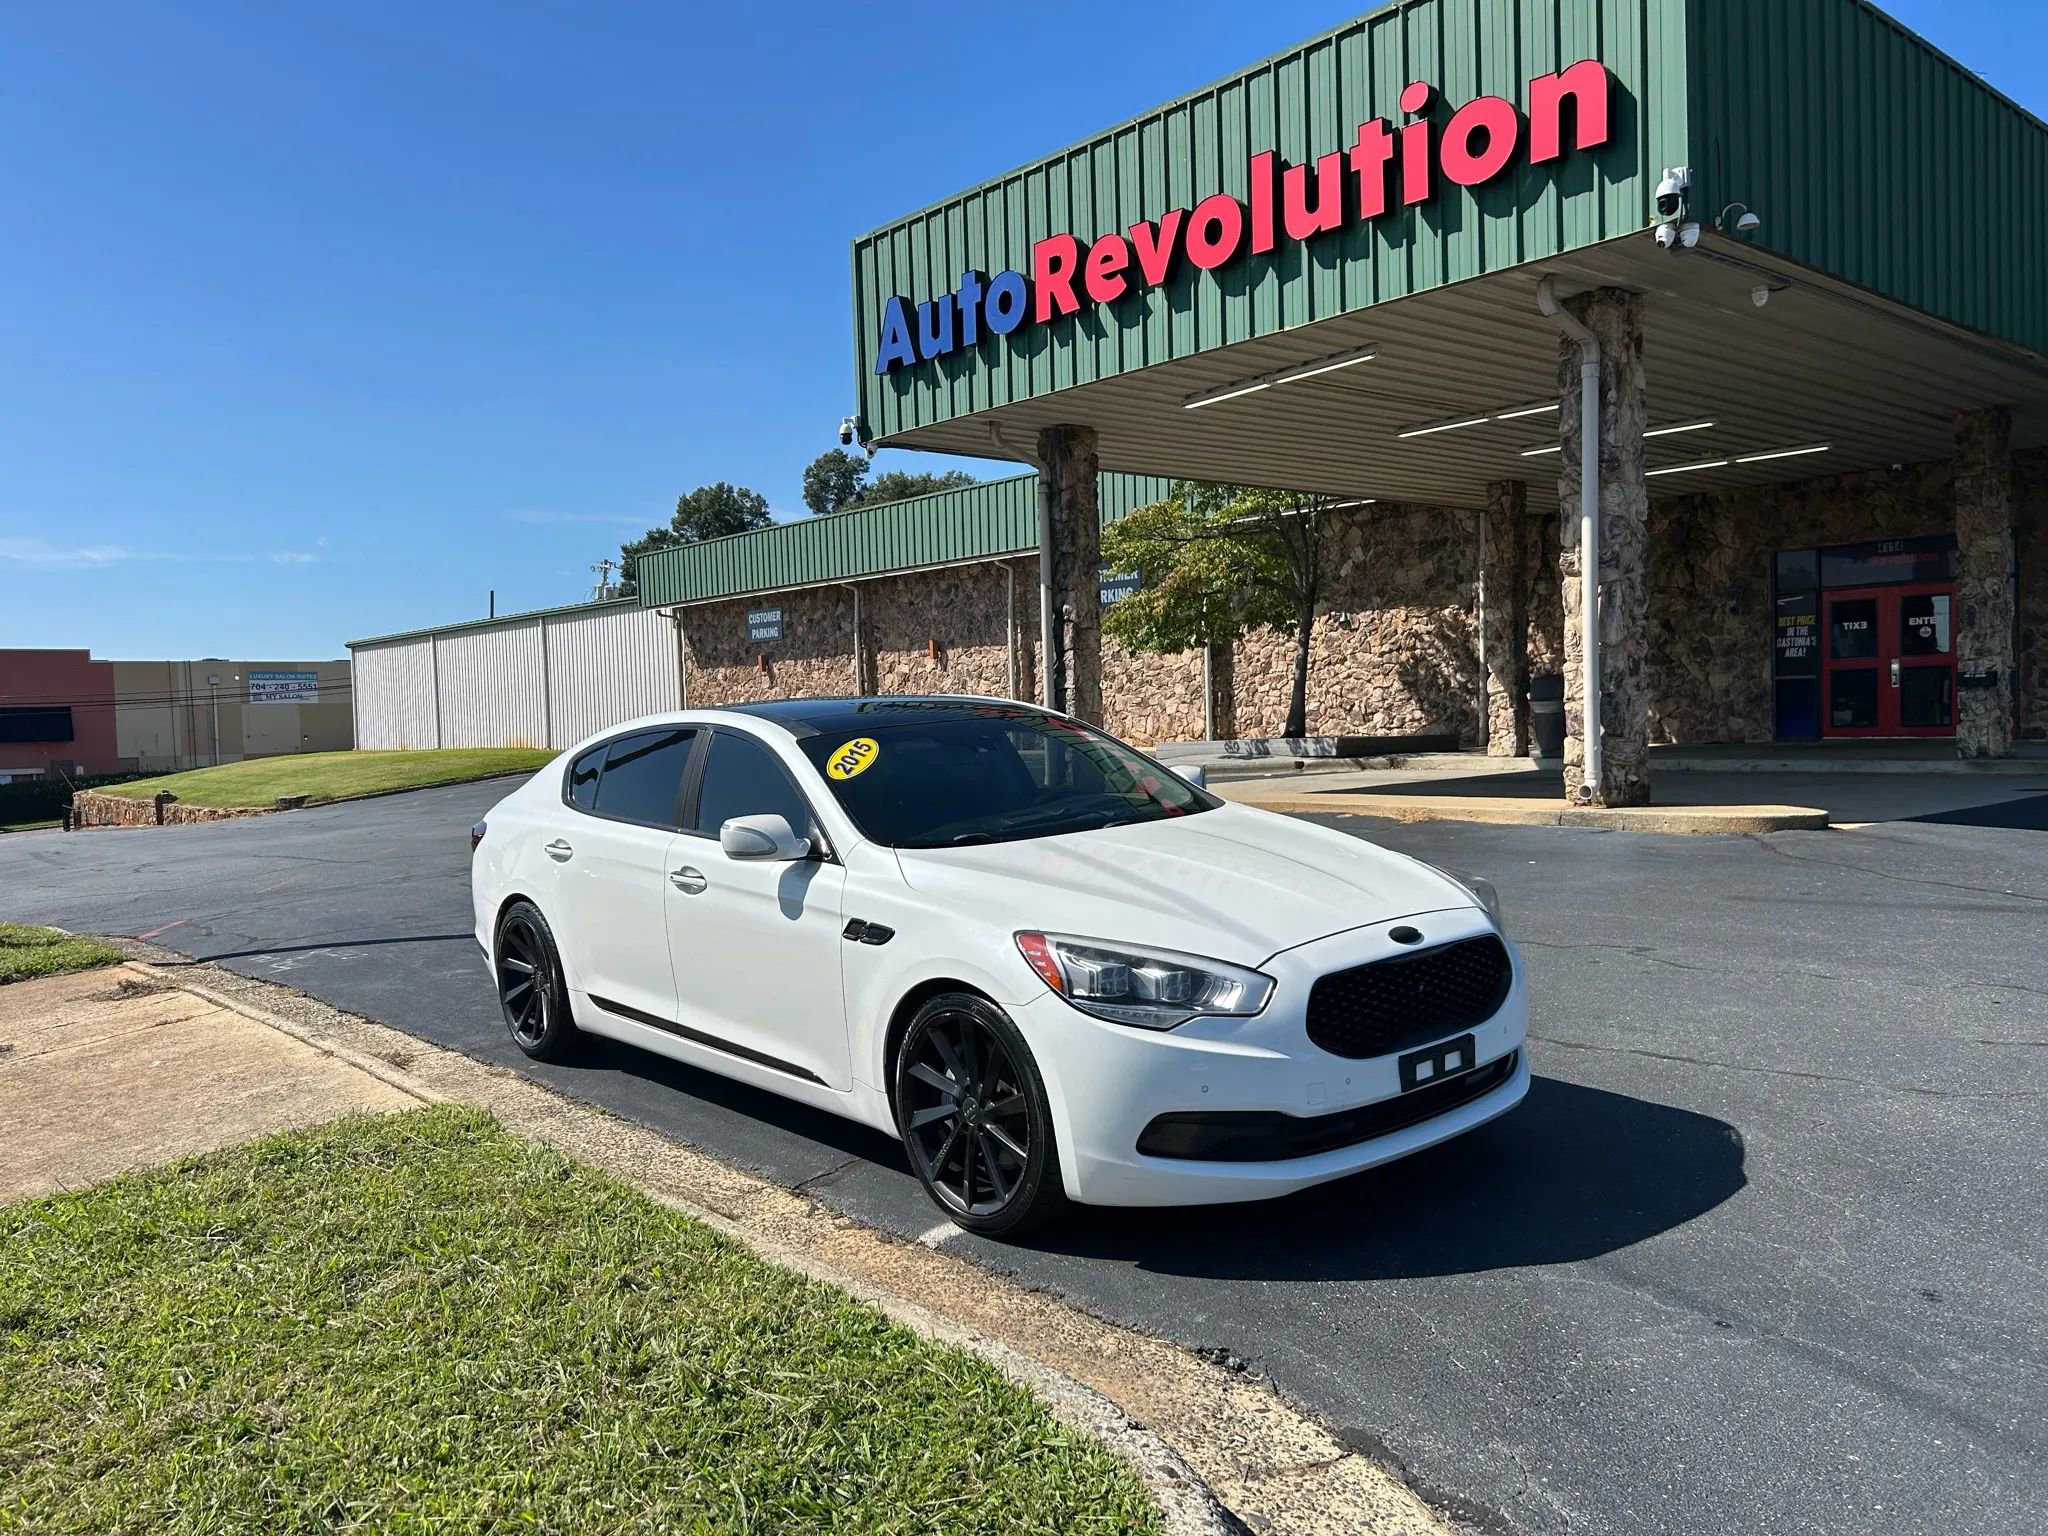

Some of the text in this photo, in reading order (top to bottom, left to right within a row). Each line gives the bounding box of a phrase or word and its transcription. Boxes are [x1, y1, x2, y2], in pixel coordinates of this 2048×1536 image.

[748, 610, 781, 624] CUSTOMER
[1778, 614, 1816, 627] BEST PRICE
[752, 626, 778, 639] PARKING
[1786, 626, 1808, 636] IN THE
[1784, 647, 1806, 657] AREA!
[833, 740, 872, 775] 2015
